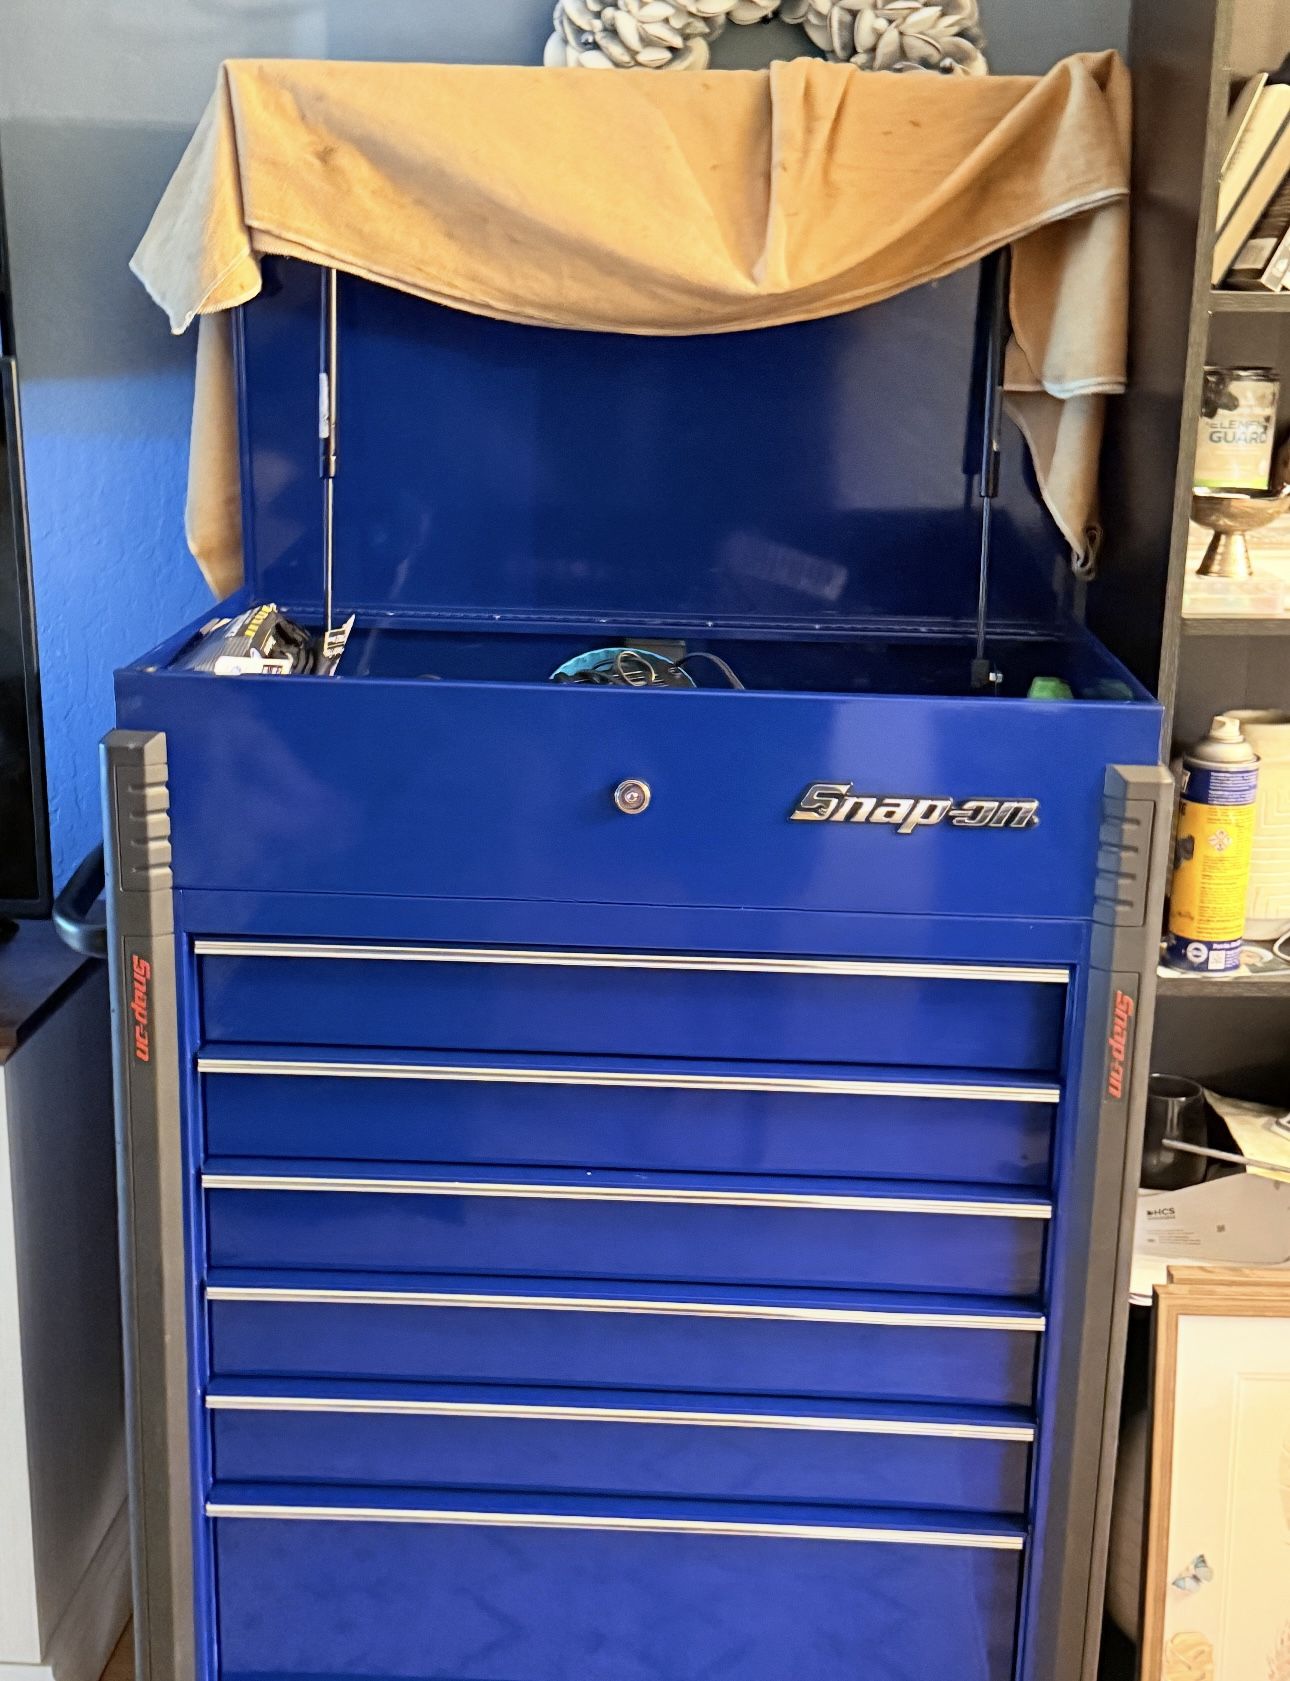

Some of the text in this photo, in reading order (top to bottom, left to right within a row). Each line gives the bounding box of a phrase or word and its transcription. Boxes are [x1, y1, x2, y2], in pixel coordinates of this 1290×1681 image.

[789, 781, 1040, 835] Snap-on
[130, 954, 152, 1062] Snap-on
[1107, 989, 1135, 1099] Snap-on
[1154, 1207, 1176, 1215] HCS
